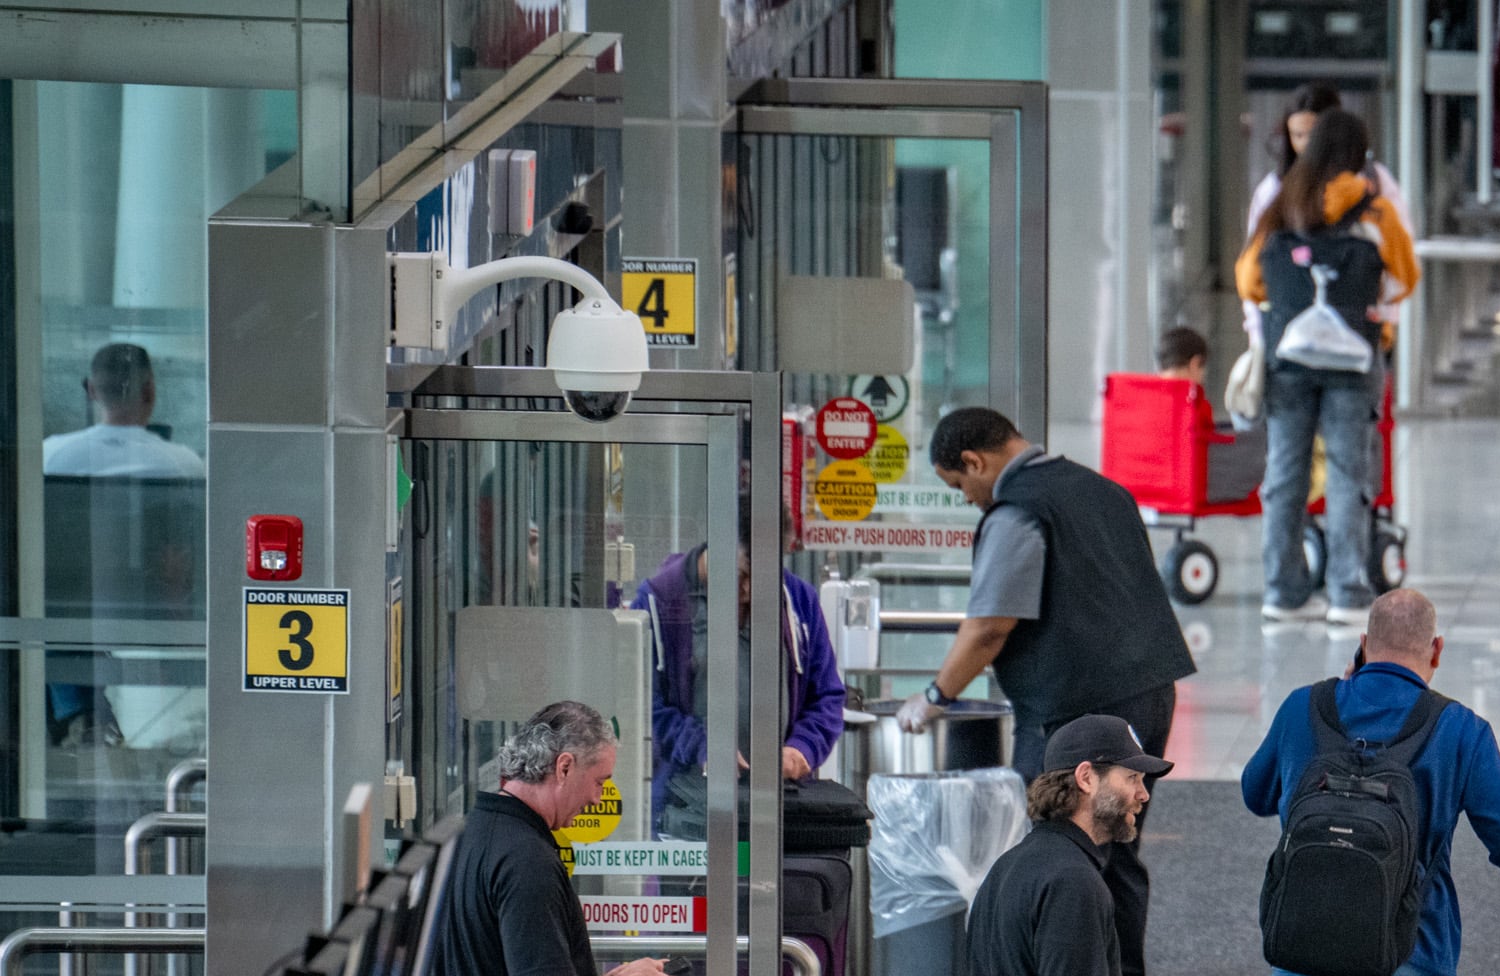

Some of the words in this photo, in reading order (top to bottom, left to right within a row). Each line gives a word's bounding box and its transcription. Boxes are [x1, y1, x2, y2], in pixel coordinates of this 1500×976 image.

[645, 262, 693, 272] NUMBER
[637, 278, 669, 328] 4
[656, 334, 689, 345] LEVEL
[823, 411, 843, 421] DO
[844, 411, 869, 422] NOT
[827, 437, 866, 449] ENTER
[816, 483, 875, 496] CAUTION
[820, 497, 872, 507] AUTOMATIC
[898, 493, 910, 505] BE
[914, 493, 939, 506] KEPT
[941, 493, 951, 506] IN
[832, 509, 859, 517] DOOR
[854, 528, 884, 545] PUSH
[887, 529, 926, 547] DOORS
[929, 530, 943, 547] TO
[248, 592, 286, 603] DOOR
[288, 592, 345, 605] NUMBER
[278, 610, 315, 671] 3
[253, 676, 296, 688] UPPER
[300, 677, 339, 690] LEVEL
[606, 850, 620, 866] BE
[624, 850, 654, 866] KEPT
[658, 850, 668, 866] IN
[584, 903, 628, 923] DOORS
[632, 904, 649, 923] TO
[652, 904, 688, 924] OPEN
